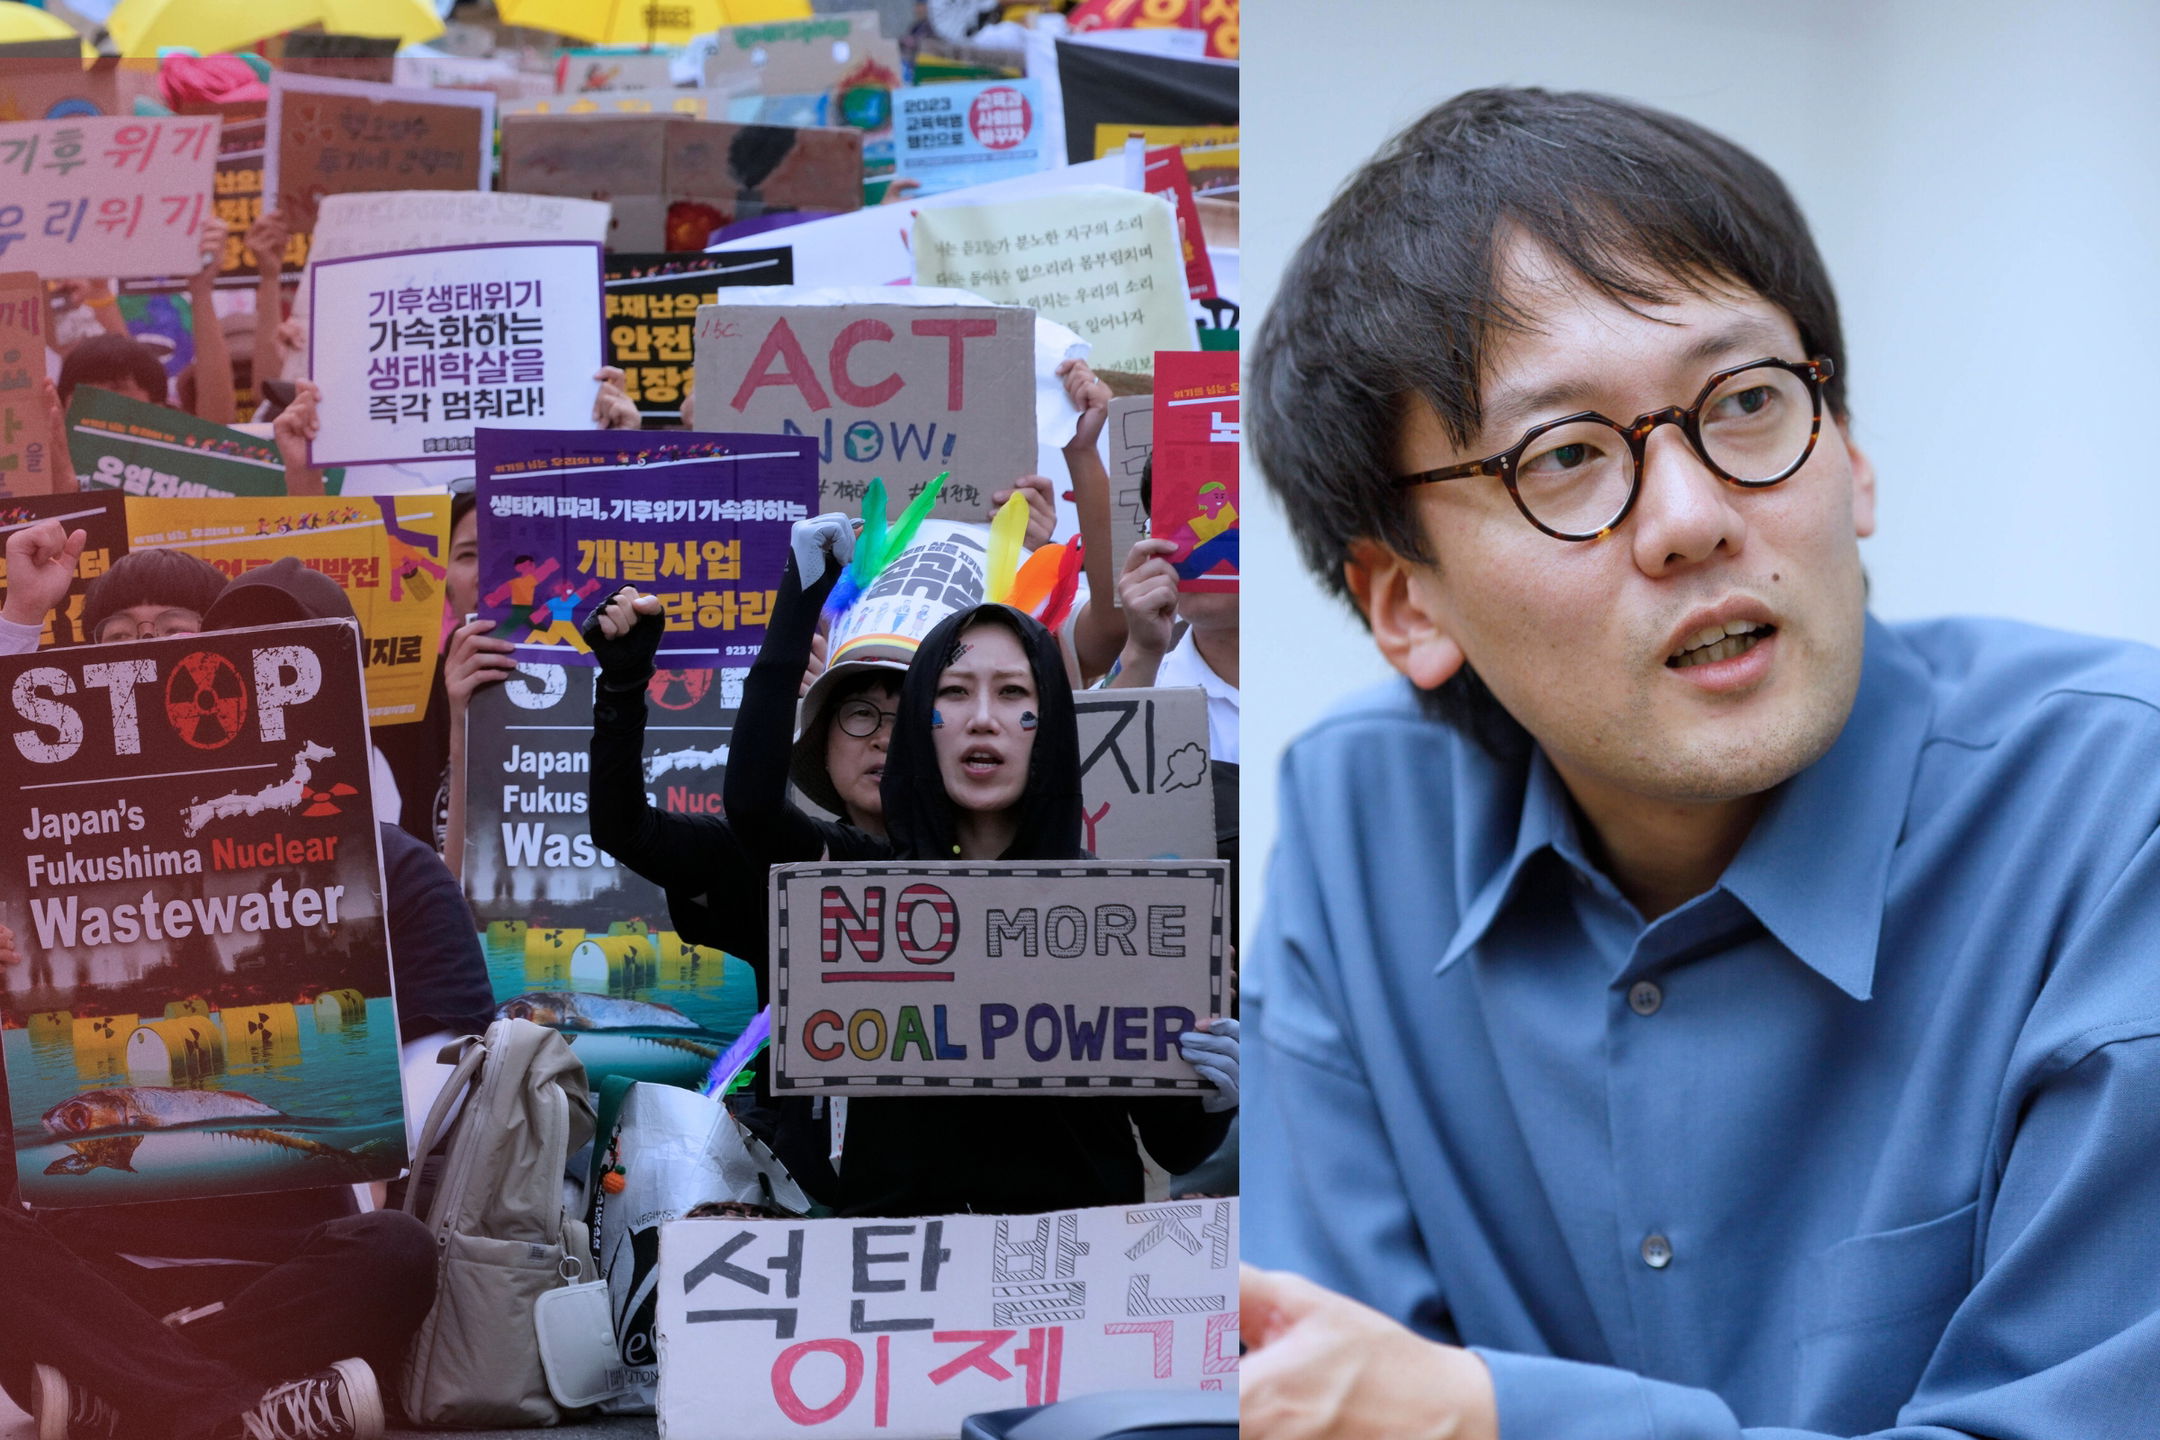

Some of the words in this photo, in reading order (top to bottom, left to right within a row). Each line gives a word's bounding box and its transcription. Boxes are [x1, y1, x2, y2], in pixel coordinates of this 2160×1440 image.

[904, 97, 951, 114] 2023
[1, 127, 86, 175] 기후
[103, 123, 213, 173] 위기
[0, 198, 89, 256] 우리
[95, 193, 204, 238] 위기
[1114, 214, 1144, 232] 소리
[368, 280, 542, 317] 기후생태위기
[1125, 275, 1154, 294] 소리
[605, 293, 718, 319] 재난으
[369, 312, 543, 352] 가속화하는
[611, 324, 695, 361] 안전
[367, 348, 545, 390] 생태학살을
[730, 316, 997, 414] ACT
[369, 392, 431, 424] 즉각
[442, 387, 545, 421] 멈춰라!
[784, 418, 957, 465] NOW!
[92, 456, 236, 498] 오염자에
[490, 495, 555, 518] 생태계
[610, 499, 696, 523] 기후위기
[698, 499, 808, 522] 가속화하는
[577, 539, 742, 582] 개발사업
[364, 635, 422, 670] 지로
[725, 645, 747, 656] 923
[747, 645, 762, 656] 기
[502, 745, 589, 779] Japan
[503, 785, 587, 814] Fukus
[667, 786, 724, 814] Nuc
[22, 799, 146, 845] Japan's
[26, 845, 202, 887] Fukushima
[212, 833, 338, 870] Nuclear
[501, 822, 617, 869] Wast
[30, 878, 345, 949] Wastewater
[820, 883, 960, 965] NO
[986, 903, 1187, 959] MORE
[802, 1003, 968, 1062] COAL
[980, 1003, 1197, 1063] POWER
[771, 1326, 1064, 1428] 이제
